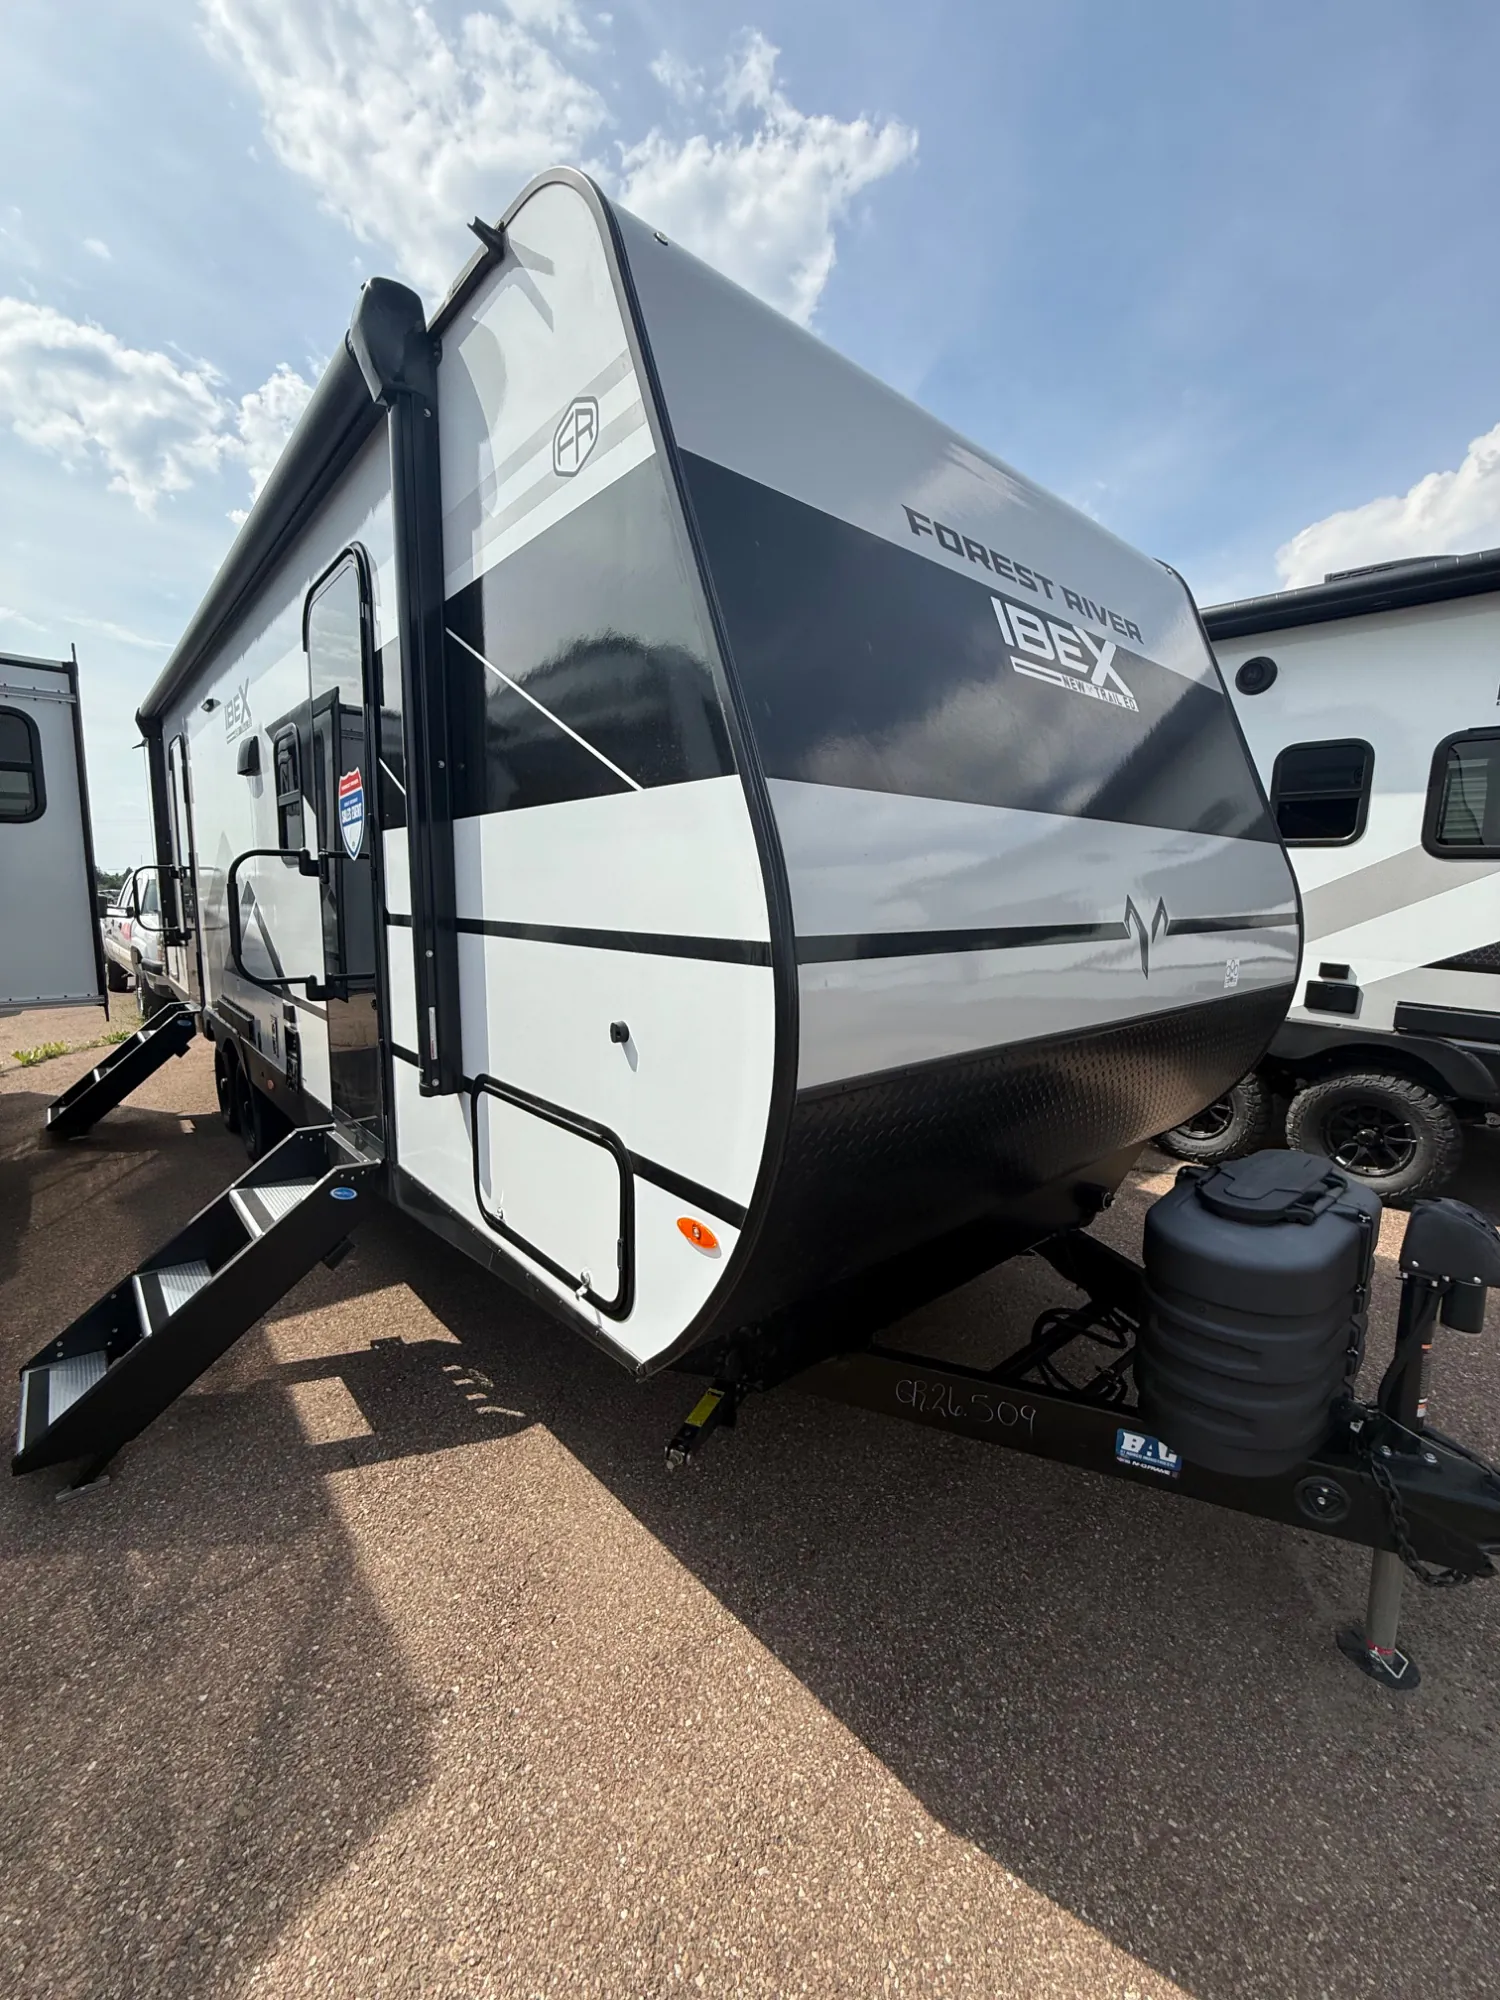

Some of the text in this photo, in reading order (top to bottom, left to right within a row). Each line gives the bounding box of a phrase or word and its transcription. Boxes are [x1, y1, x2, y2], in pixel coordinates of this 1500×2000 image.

[901, 503, 1145, 645] FOREST RIVER
[990, 595, 1135, 699] IBEX
[224, 677, 252, 731] IBEX
[1062, 675, 1086, 694] NEW
[1094, 686, 1123, 706] TRAIL
[1120, 1432, 1178, 1463] BAL
